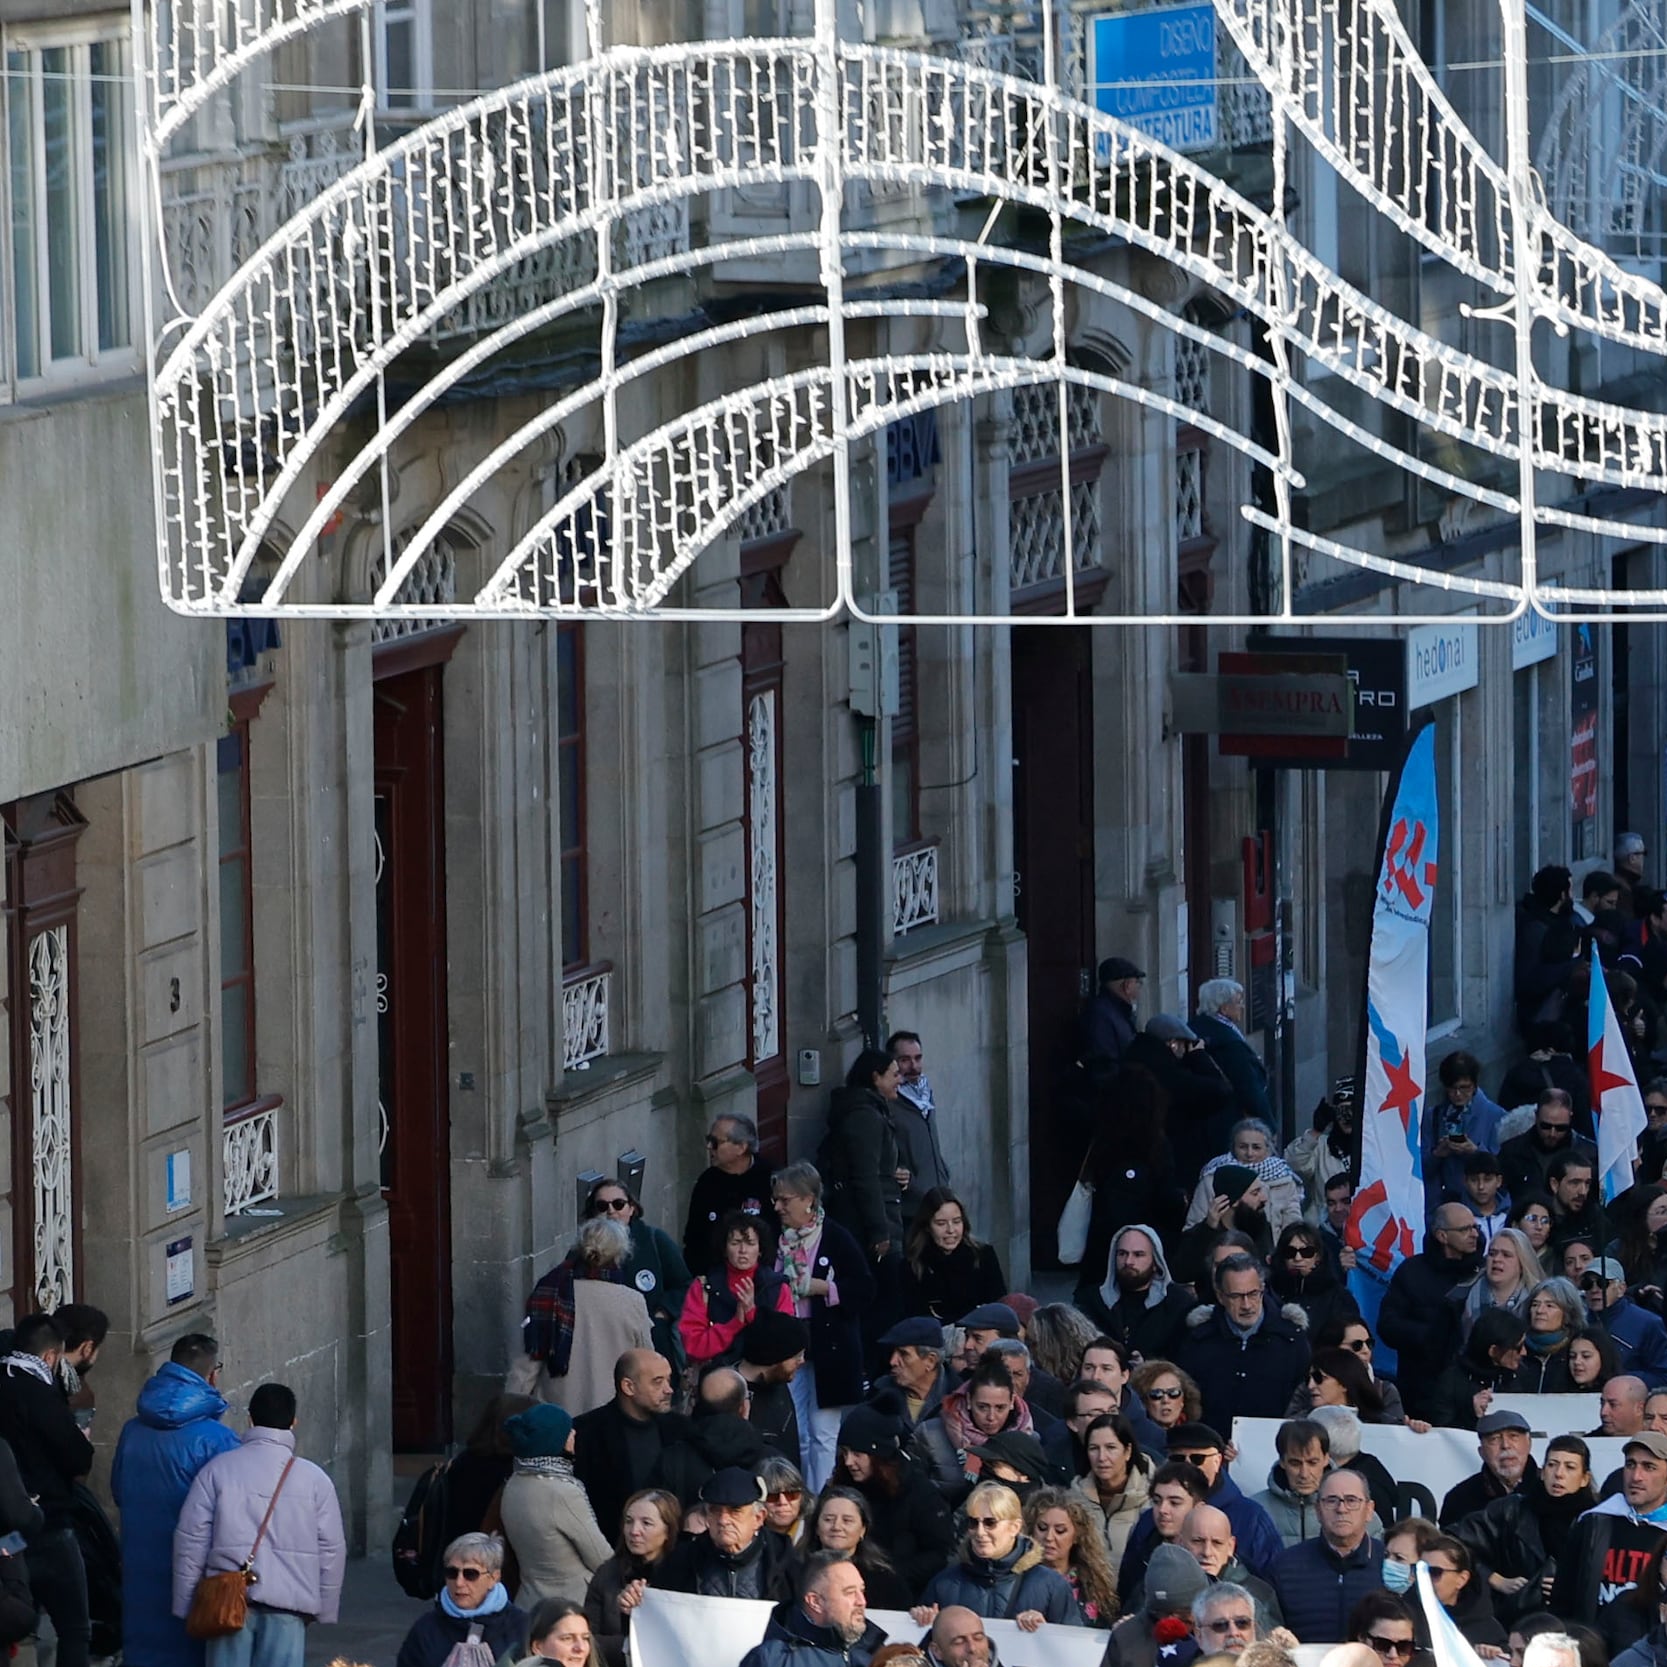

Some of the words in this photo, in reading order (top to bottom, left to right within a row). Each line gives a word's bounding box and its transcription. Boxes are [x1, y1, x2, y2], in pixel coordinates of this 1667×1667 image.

[1160, 12, 1211, 58] DISEÑO
[1115, 66, 1213, 114] COMPOSTELA
[1416, 626, 1465, 680] hedonai
[1603, 1548, 1652, 1583] ALT
